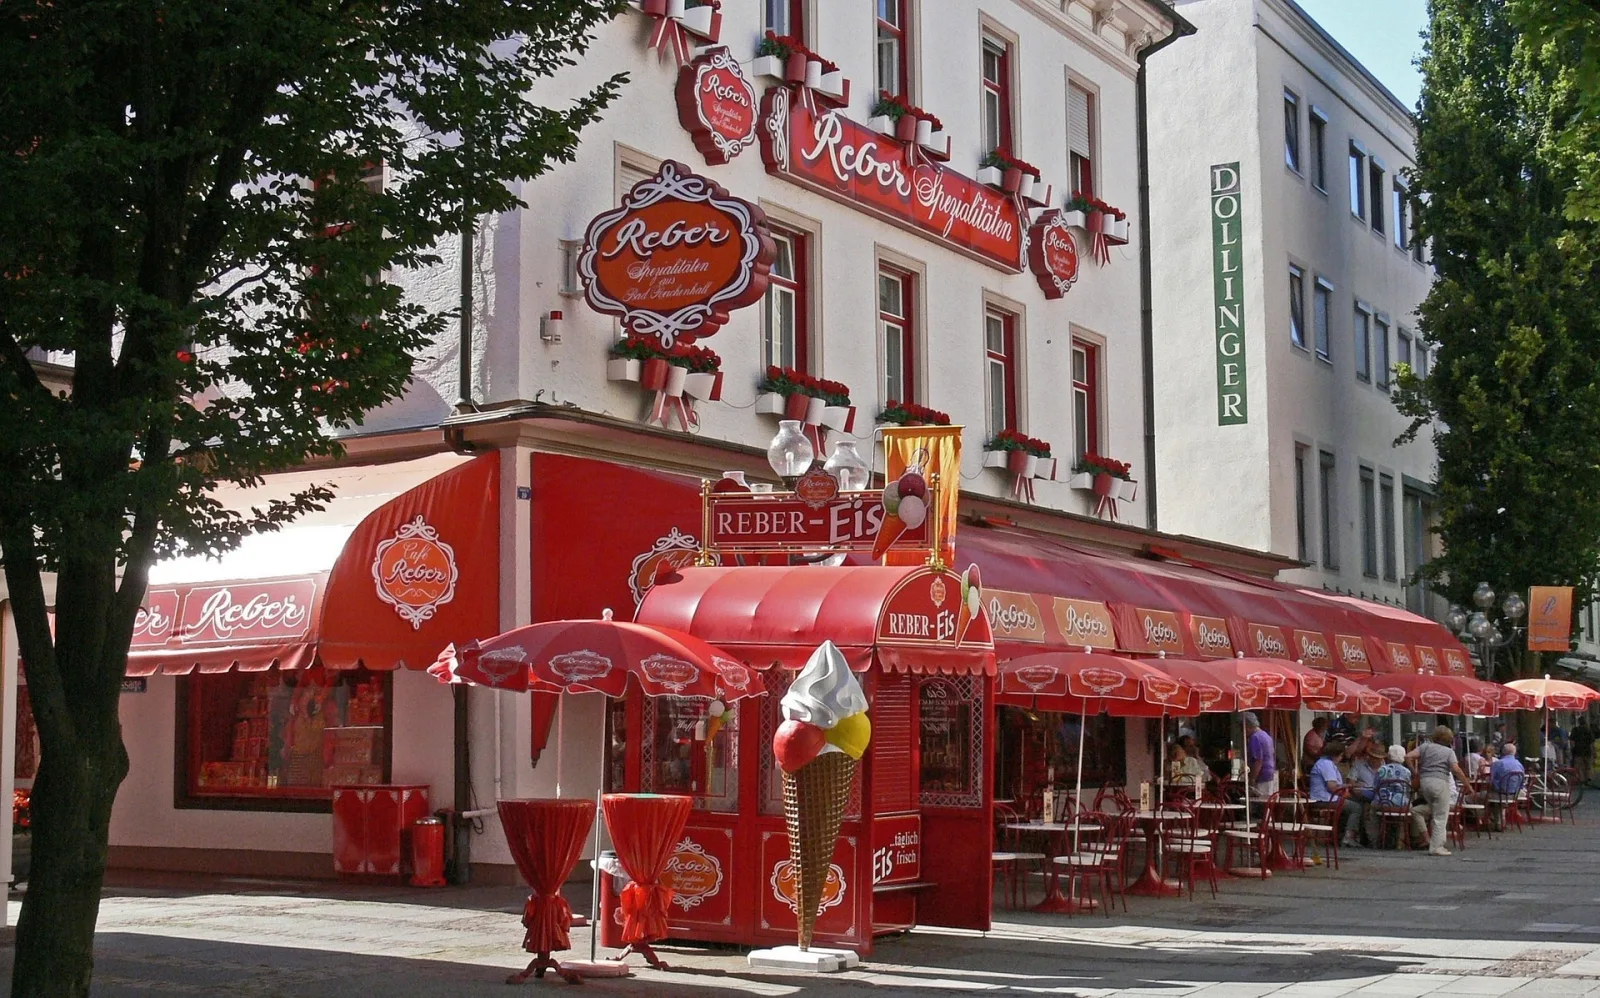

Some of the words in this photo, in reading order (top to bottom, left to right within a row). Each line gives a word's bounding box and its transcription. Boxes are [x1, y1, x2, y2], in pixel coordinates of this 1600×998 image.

[703, 74, 749, 107] Reber
[801, 111, 911, 197] Reber
[913, 164, 1012, 242] Spezialitäten
[602, 218, 730, 257] Reber
[1047, 231, 1074, 255] Reber
[627, 258, 709, 287] Spezialitäten
[659, 276, 676, 285] aus
[1213, 167, 1243, 418] DOLLINGER
[403, 542, 432, 564] Café
[384, 559, 447, 586] Reber
[186, 588, 305, 636] Reber
[990, 597, 1037, 634] Reber
[1065, 605, 1107, 640] Reber
[1144, 615, 1178, 647] Reber
[1199, 622, 1231, 651] Reber
[1257, 629, 1286, 657] Reber
[1302, 635, 1329, 662] Reber
[1342, 640, 1367, 666] Reber
[663, 857, 713, 874] Reber
[873, 847, 893, 885] Eis
[897, 850, 916, 865] frisch
